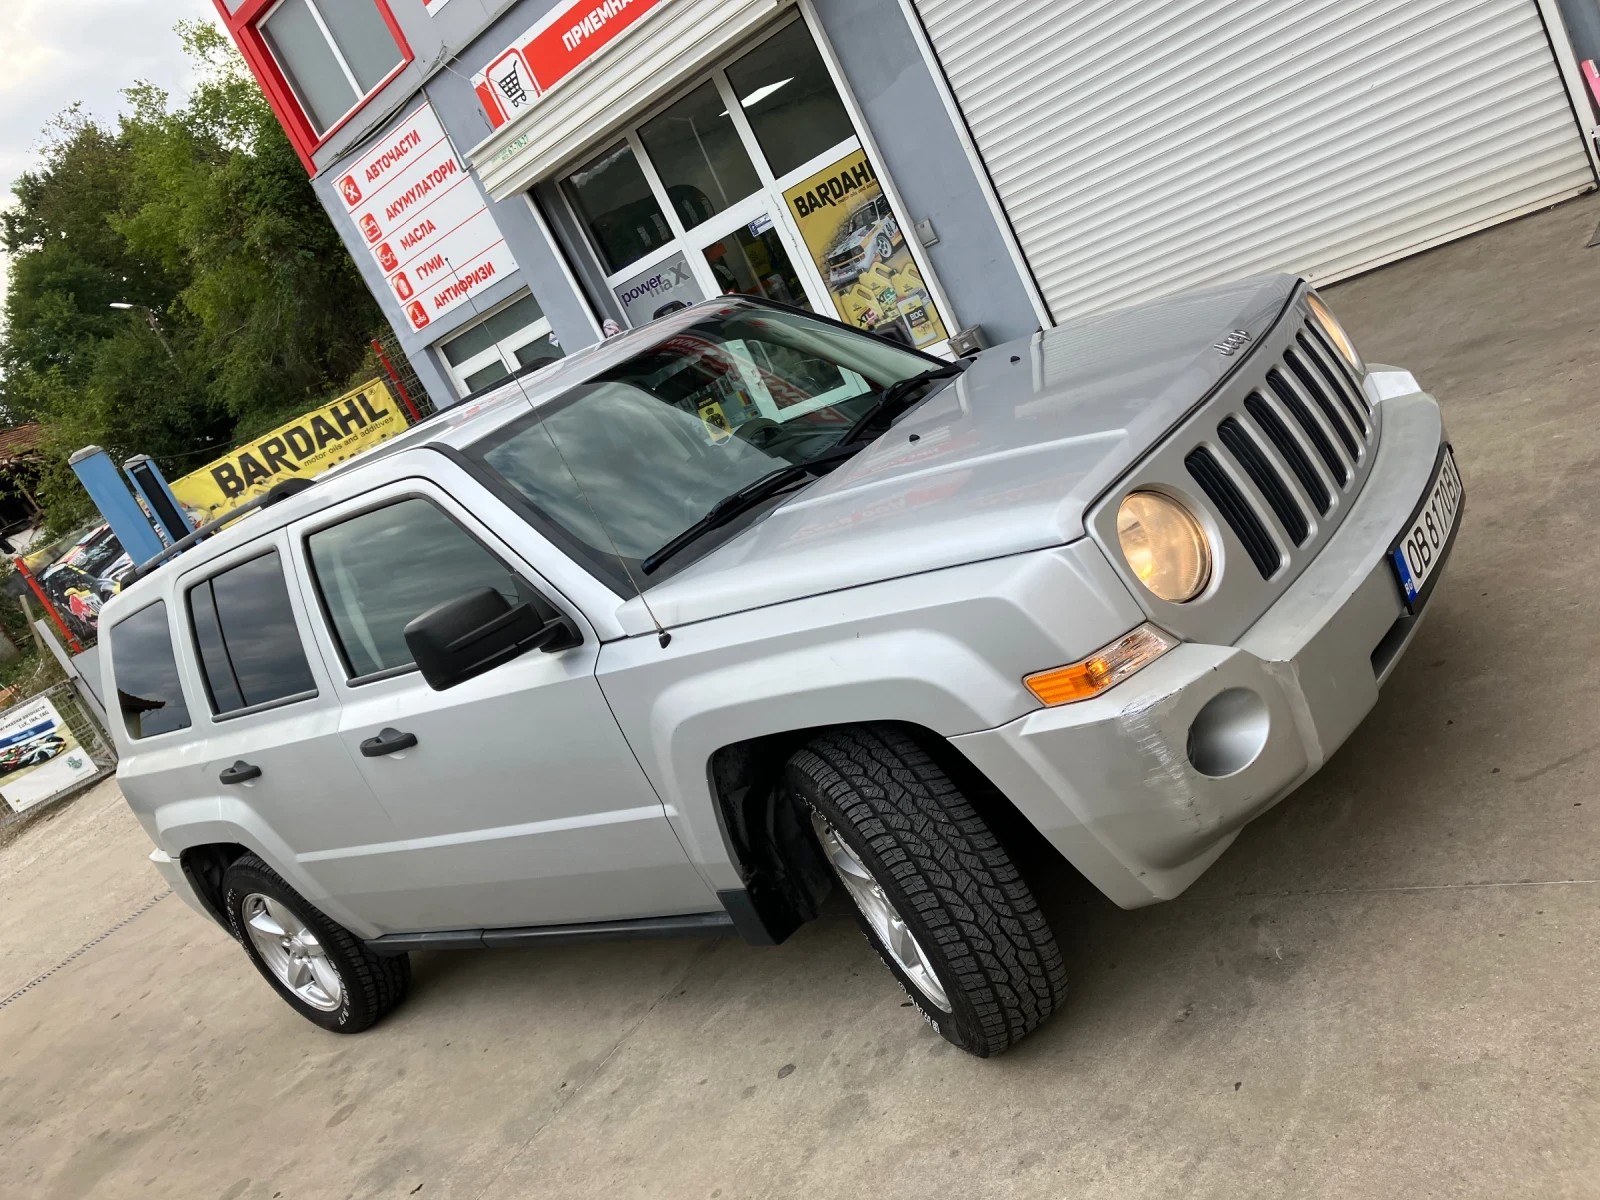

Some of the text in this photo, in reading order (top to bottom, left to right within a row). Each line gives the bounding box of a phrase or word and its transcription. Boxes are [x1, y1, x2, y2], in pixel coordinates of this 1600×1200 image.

[365, 130, 421, 183] АВТОЧАСТИ
[385, 158, 457, 221] АКУМУЛАТОРИ
[400, 219, 436, 251] МАСЛА
[415, 254, 445, 280] ГУМИ
[433, 261, 496, 309] АНТИФРИЗИ
[621, 274, 662, 307] power
[909, 310, 923, 321] BDC
[1214, 329, 1251, 356] Jeep
[210, 393, 389, 498] BARDAHL
[304, 416, 394, 467] motor oils and additives
[1404, 578, 1414, 596] BG
